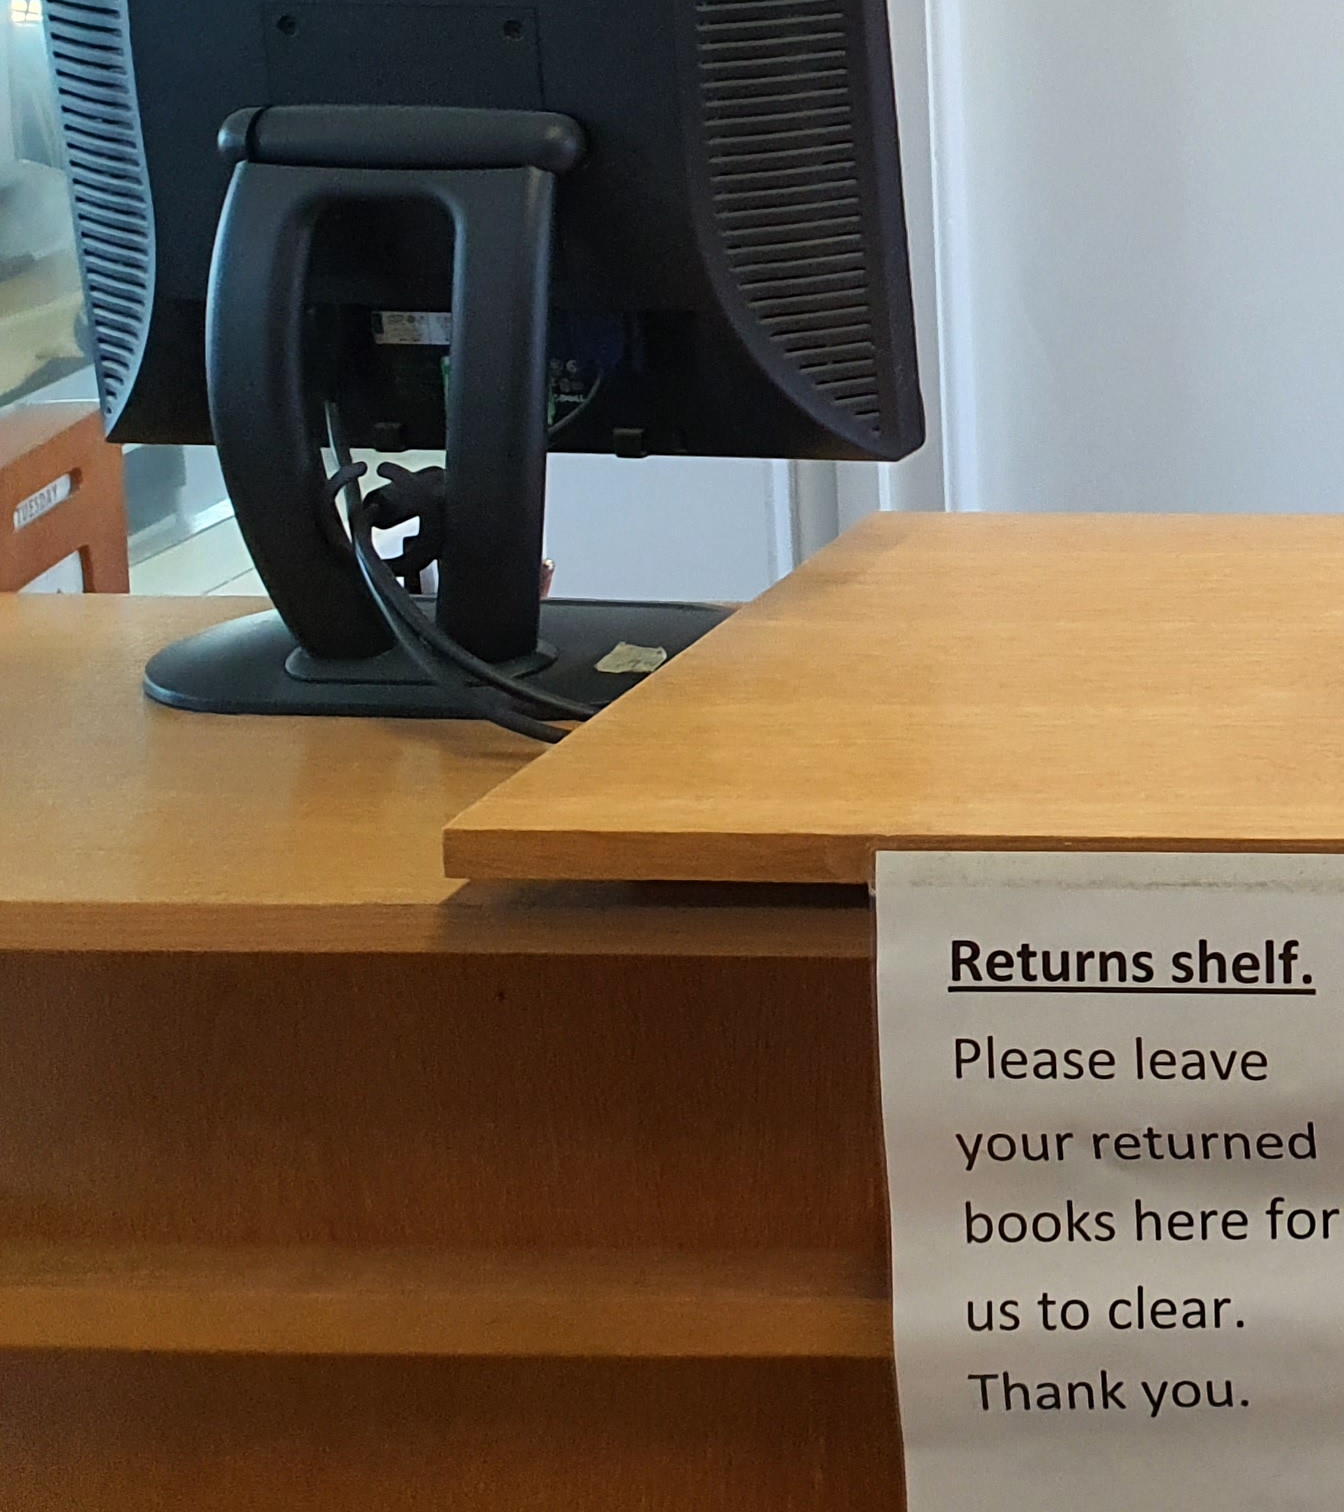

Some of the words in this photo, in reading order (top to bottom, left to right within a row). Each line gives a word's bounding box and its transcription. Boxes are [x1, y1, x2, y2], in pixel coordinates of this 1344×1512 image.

[949, 939, 1155, 983] Returns
[1171, 939, 1314, 985] shelf.
[953, 1036, 1116, 1080] Please
[1135, 1037, 1268, 1081] leave
[955, 1128, 1074, 1170] your
[1092, 1123, 1318, 1162] returned
[964, 1201, 1115, 1244] books
[1135, 1199, 1249, 1241] here
[1266, 1198, 1340, 1240] for
[965, 1297, 1020, 1332] us
[1038, 1292, 1090, 1331] to
[1108, 1285, 1246, 1330] clear.
[968, 1370, 1126, 1412] Thank
[1141, 1381, 1249, 1418] you.
